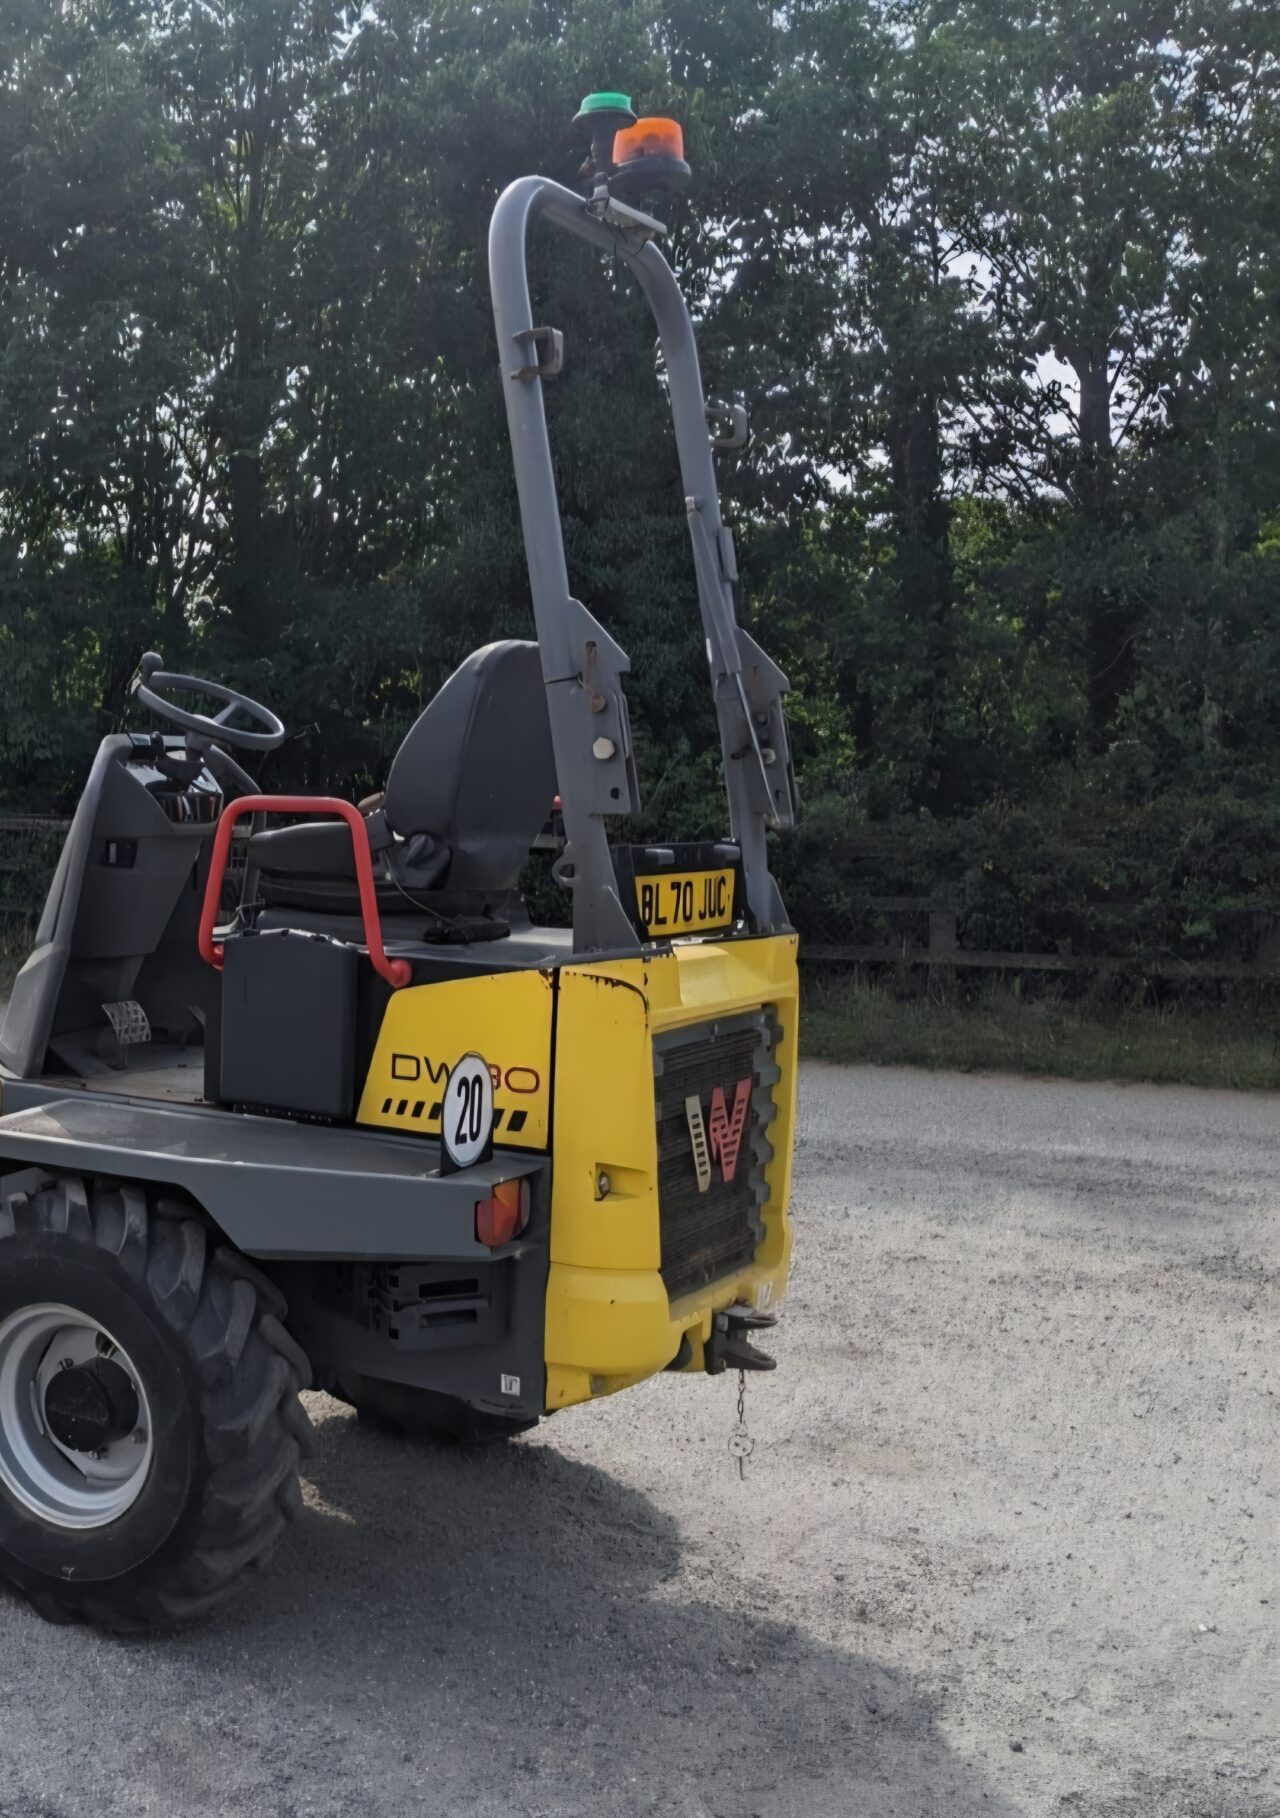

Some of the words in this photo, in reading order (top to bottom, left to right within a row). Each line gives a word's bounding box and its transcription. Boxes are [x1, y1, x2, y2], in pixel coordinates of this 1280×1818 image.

[641, 883, 667, 926] BL
[670, 881, 694, 924] 70
[698, 875, 727, 920] JUC
[454, 1073, 483, 1146] 20
